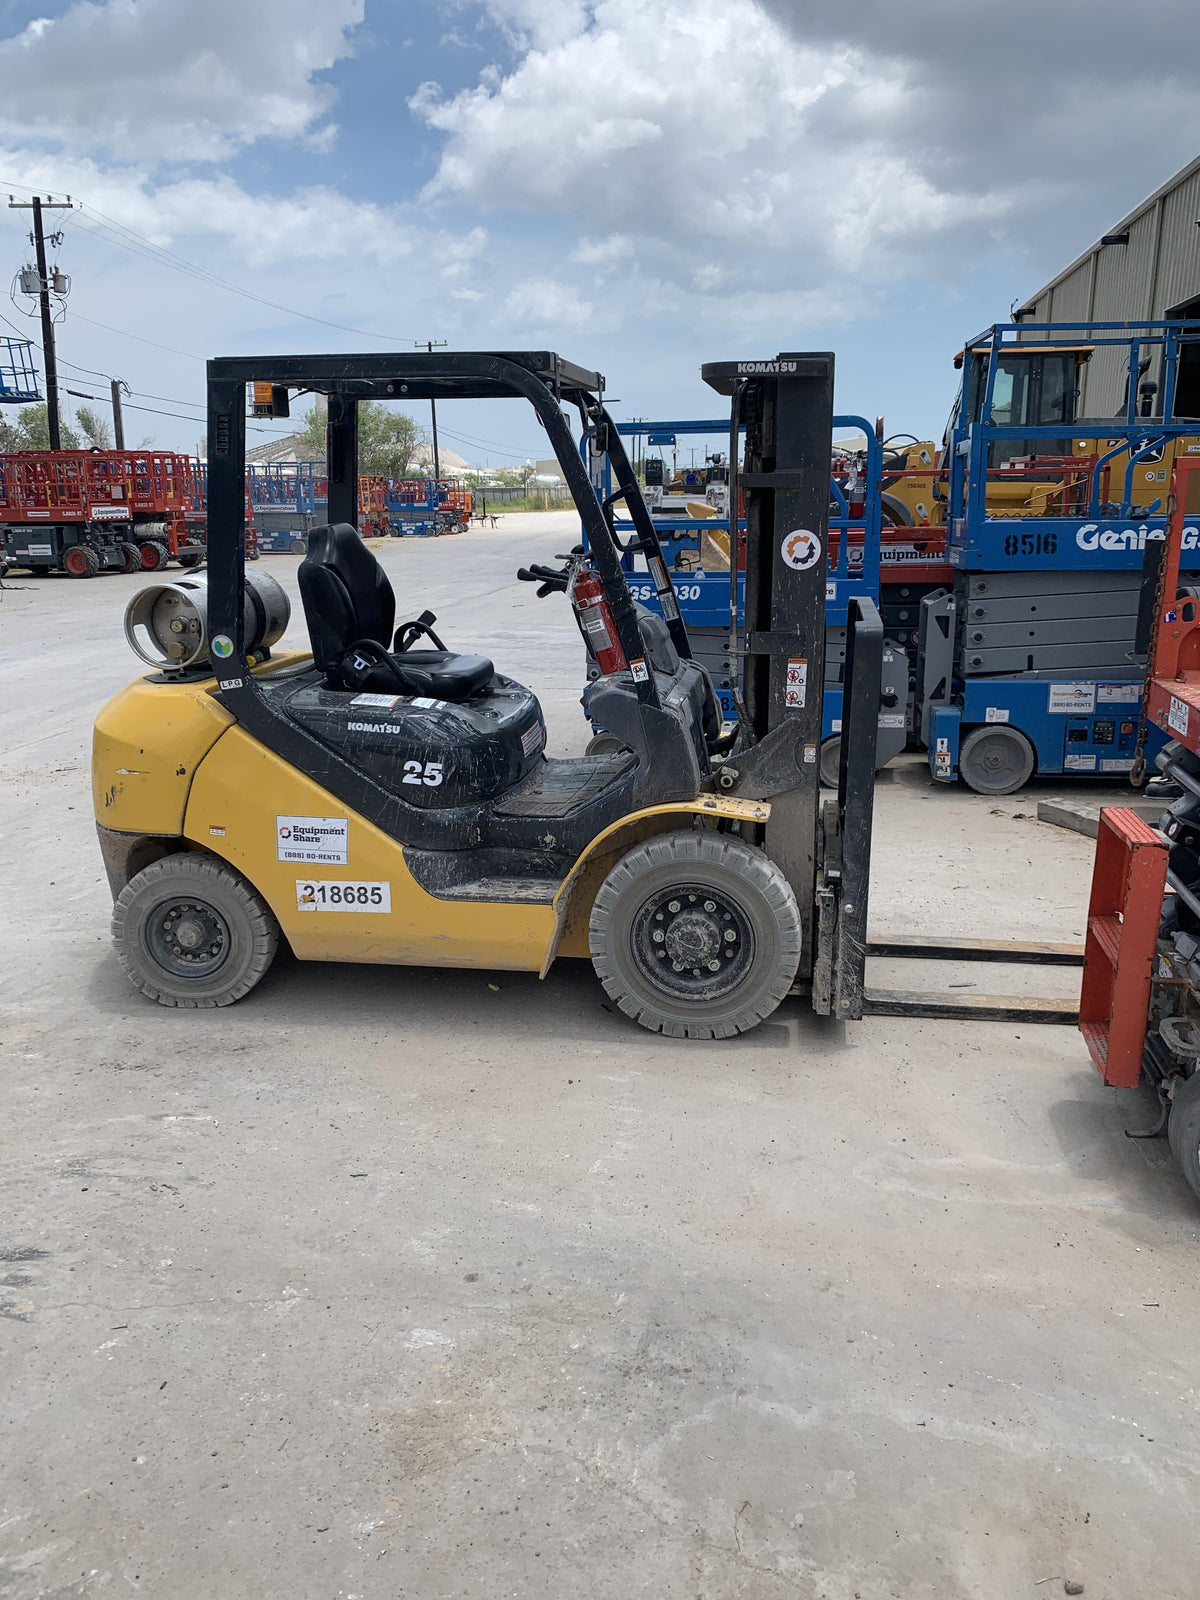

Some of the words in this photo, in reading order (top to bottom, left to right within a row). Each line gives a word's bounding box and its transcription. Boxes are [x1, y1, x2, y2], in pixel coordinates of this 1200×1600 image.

[737, 361, 797, 373] KOMATSU
[1180, 526, 1200, 550] G
[1004, 533, 1058, 556] 8516
[630, 585, 701, 601] GS-30
[221, 680, 242, 688] LPG
[347, 722, 401, 734] KOMATSU
[402, 760, 443, 787] 25
[292, 825, 345, 836] Equipment
[292, 834, 321, 843] Share
[284, 851, 305, 859] (888)
[306, 853, 341, 861] 80-RENTS
[303, 885, 382, 905] 218685
